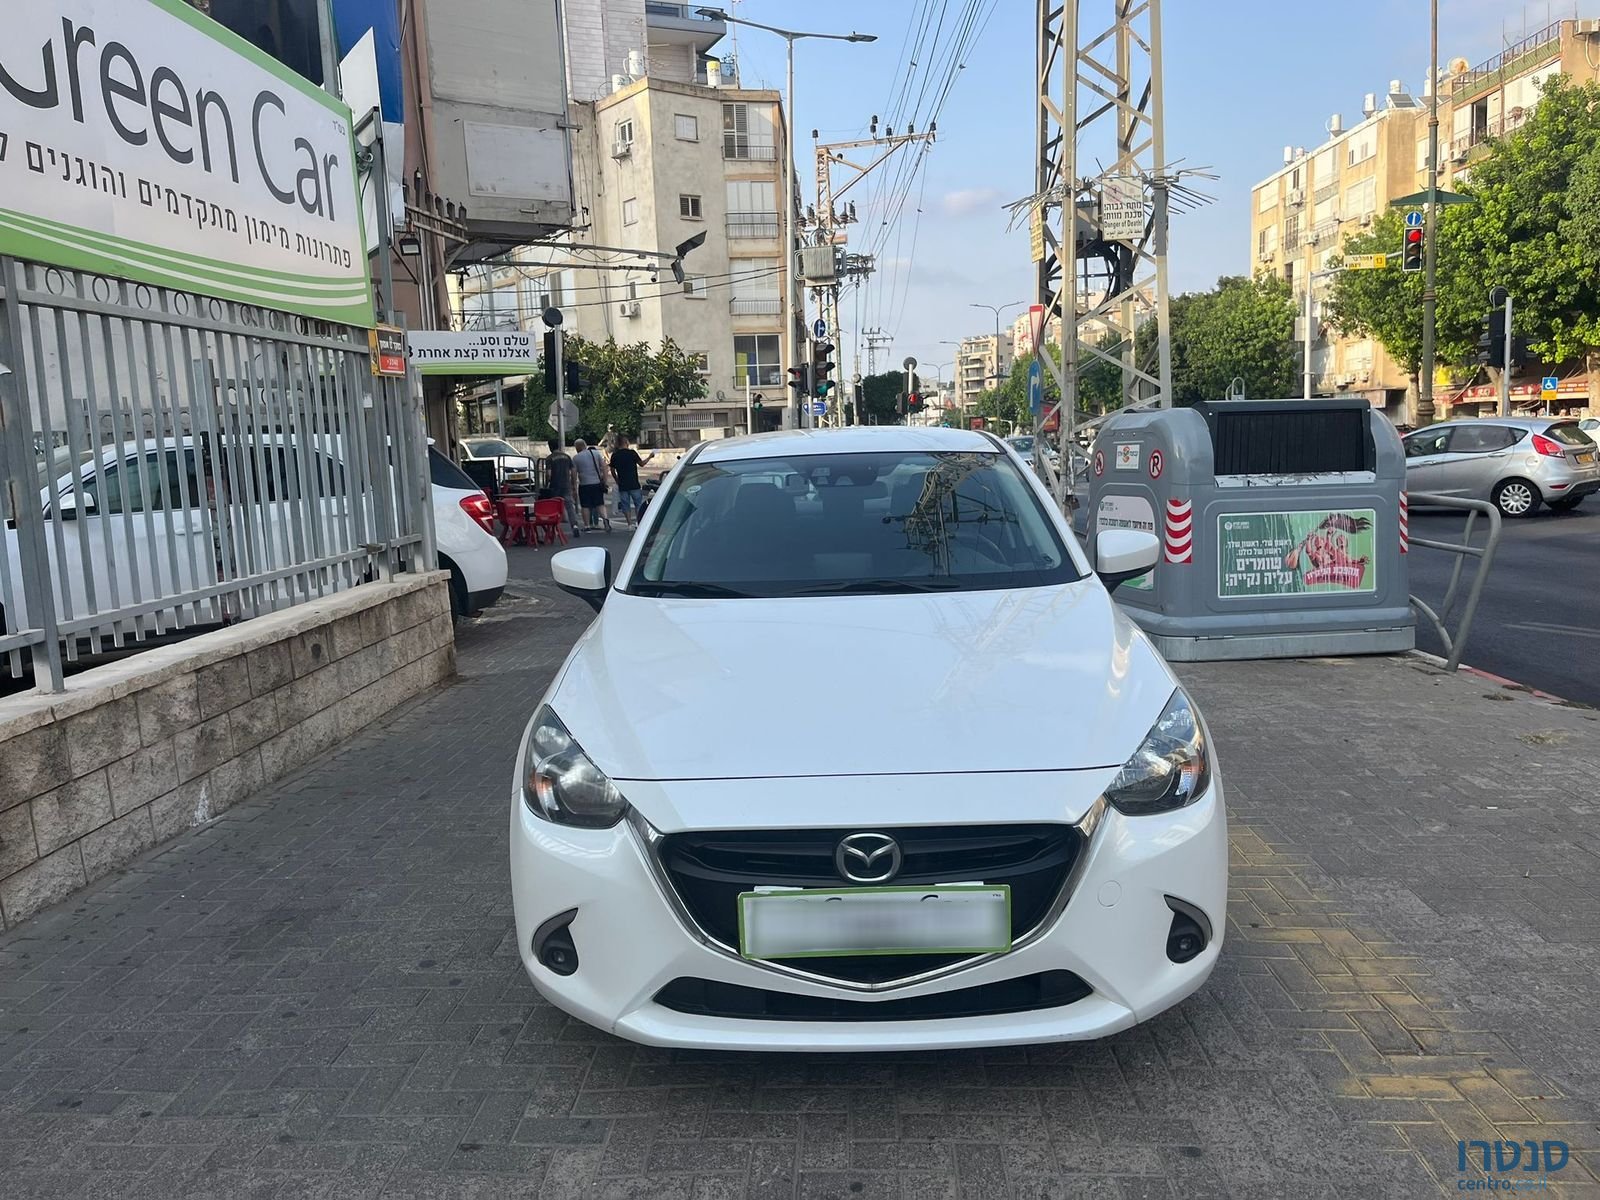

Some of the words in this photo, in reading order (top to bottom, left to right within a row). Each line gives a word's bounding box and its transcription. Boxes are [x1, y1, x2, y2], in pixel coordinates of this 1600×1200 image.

[252, 90, 339, 222] Car
[25, 140, 127, 199] והוגנים
[137, 178, 238, 233] מתקדמים
[1104, 202, 1124, 211] גבוה!
[1126, 201, 1142, 210] מתח
[1103, 212, 1122, 220] מוות!
[1124, 210, 1142, 219] סכנת
[1103, 220, 1121, 230] Danger
[1121, 220, 1127, 228] of
[244, 215, 290, 249] מימון
[295, 232, 352, 269] פתרונות
[468, 336, 500, 346] וסע...
[503, 334, 529, 346] שלם
[417, 348, 451, 358] אחרת
[454, 348, 479, 360] קצת
[482, 348, 495, 358] זה
[499, 347, 530, 358] אצלנו
[1236, 556, 1282, 571] שומרים
[1225, 573, 1261, 588] נקייה!
[1264, 570, 1293, 586] עליה
